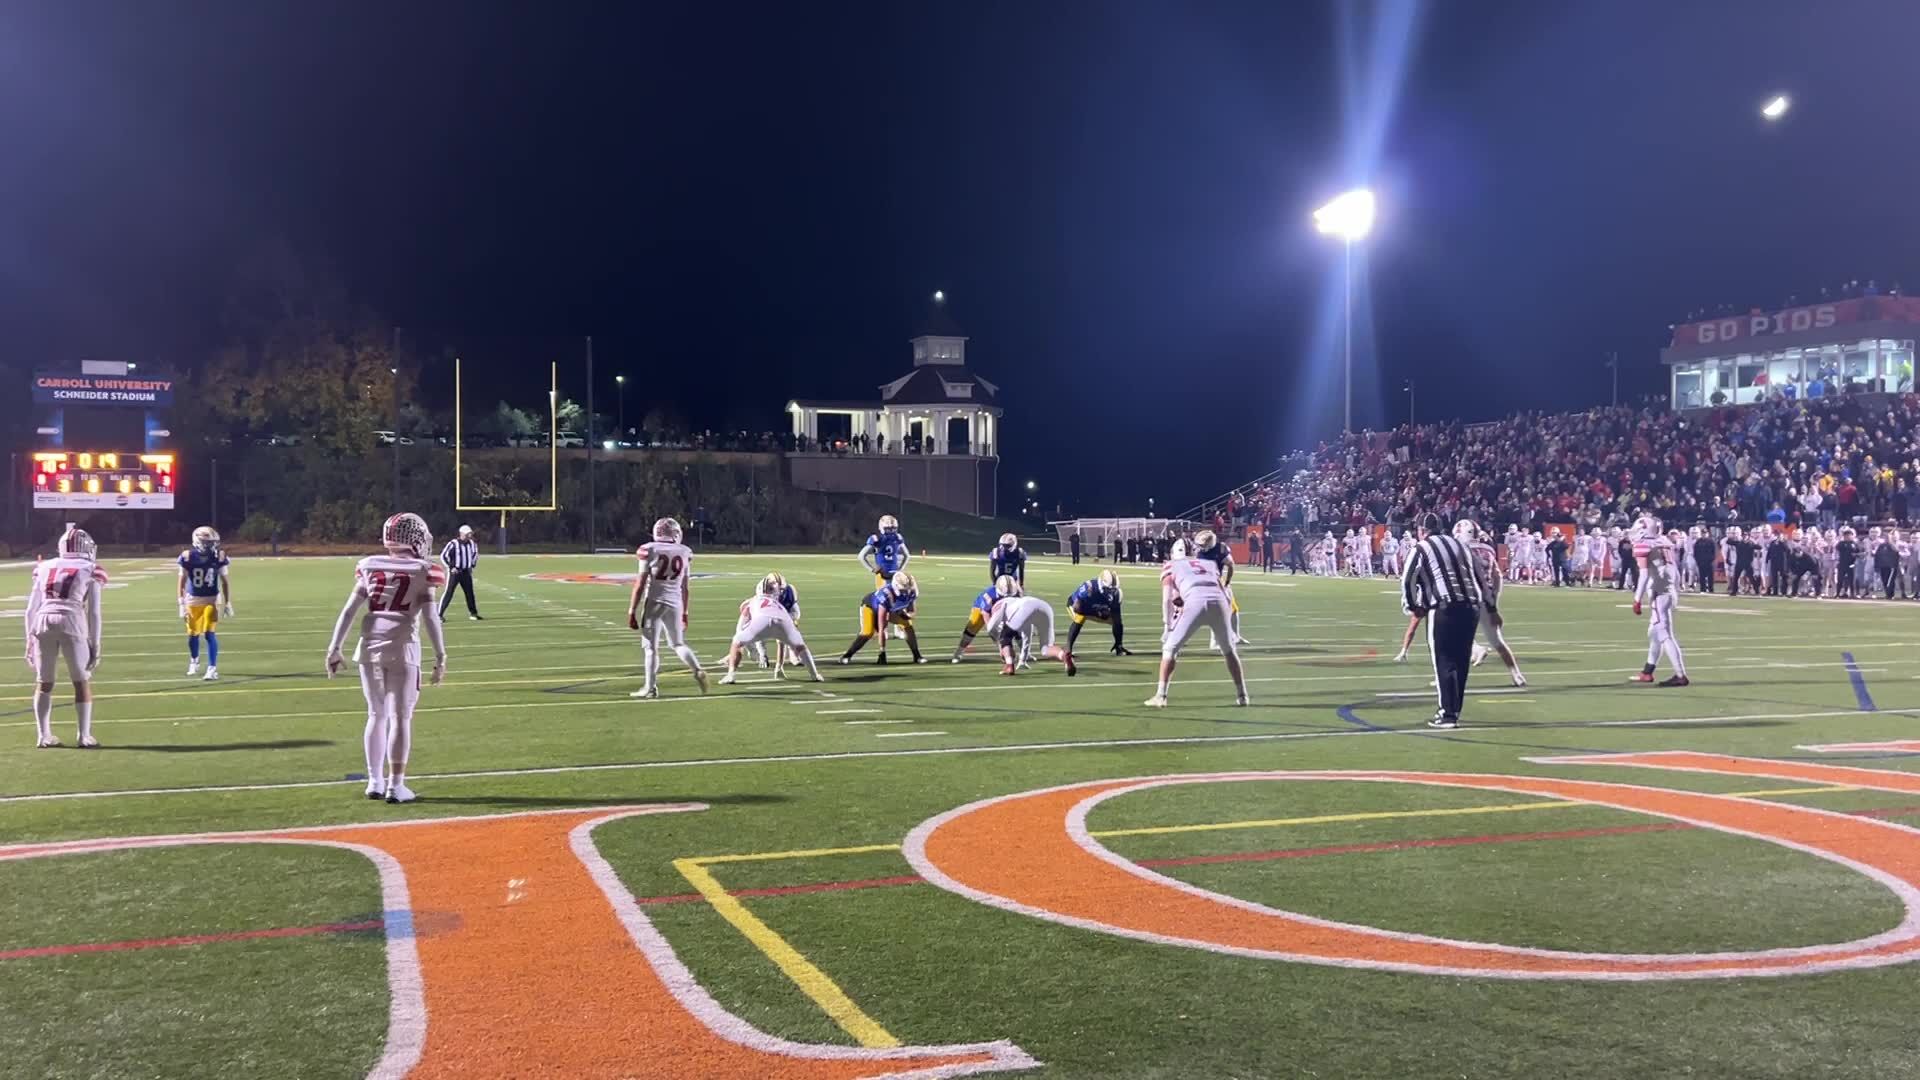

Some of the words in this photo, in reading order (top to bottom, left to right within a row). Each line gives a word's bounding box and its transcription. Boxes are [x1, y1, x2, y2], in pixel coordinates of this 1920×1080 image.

[1697, 320, 1738, 343] GO
[1750, 306, 1836, 336] PIOS
[37, 378, 92, 388] CARROLL
[95, 379, 172, 391] UNIVERSITY
[53, 390, 108, 400] SCHNEIDER
[110, 391, 155, 401] STADIUM
[192, 567, 215, 588] 84
[655, 554, 684, 581] 29
[1188, 560, 1208, 575] 5
[46, 567, 80, 599] 17
[369, 570, 411, 611] 22
